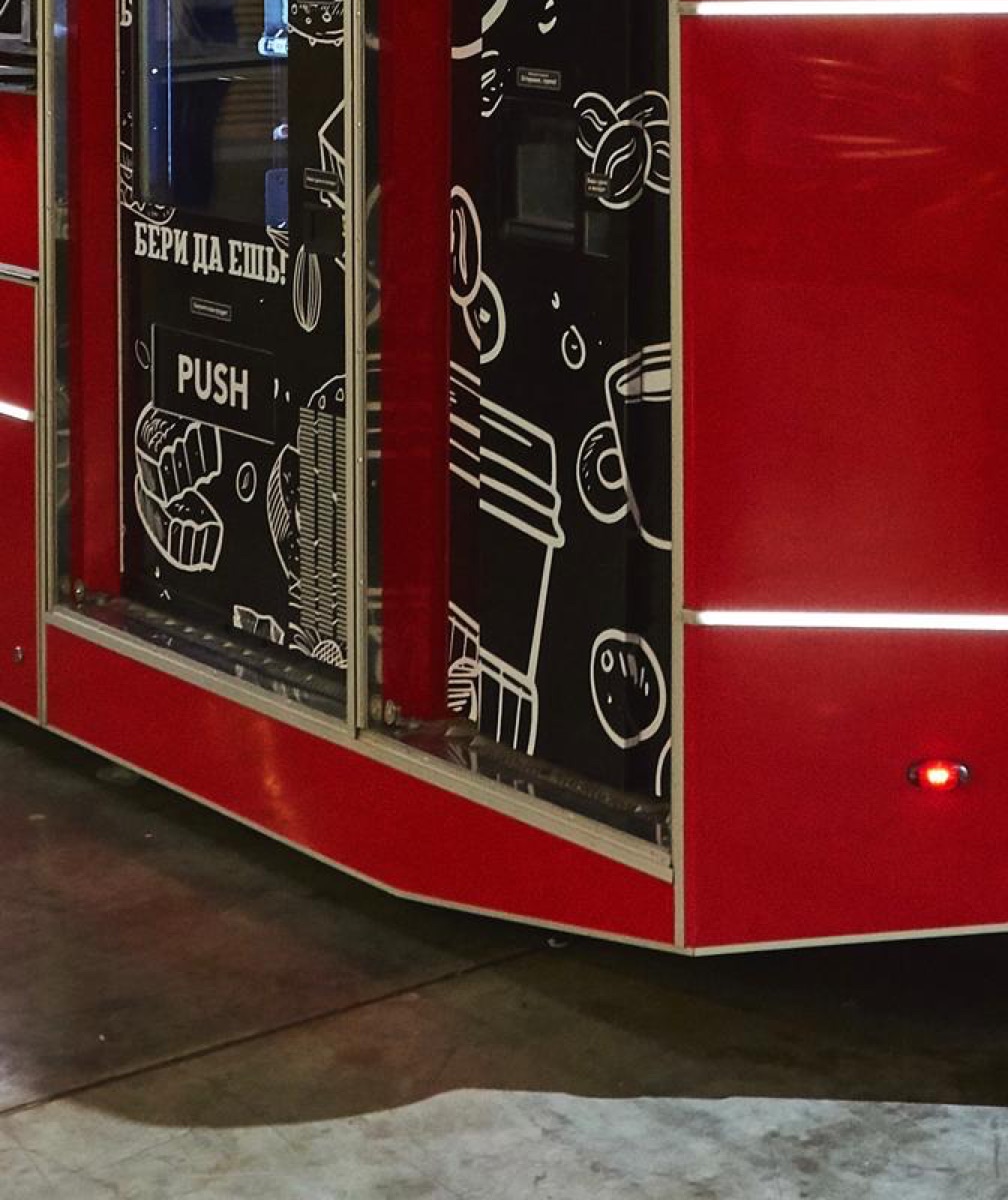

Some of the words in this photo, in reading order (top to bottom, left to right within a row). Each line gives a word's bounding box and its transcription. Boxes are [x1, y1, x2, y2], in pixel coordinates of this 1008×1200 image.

[134, 221, 189, 265] БЕРИ
[192, 232, 224, 275] ДА
[228, 239, 286, 286] ЕШЬ!
[177, 353, 249, 411] PUSH
